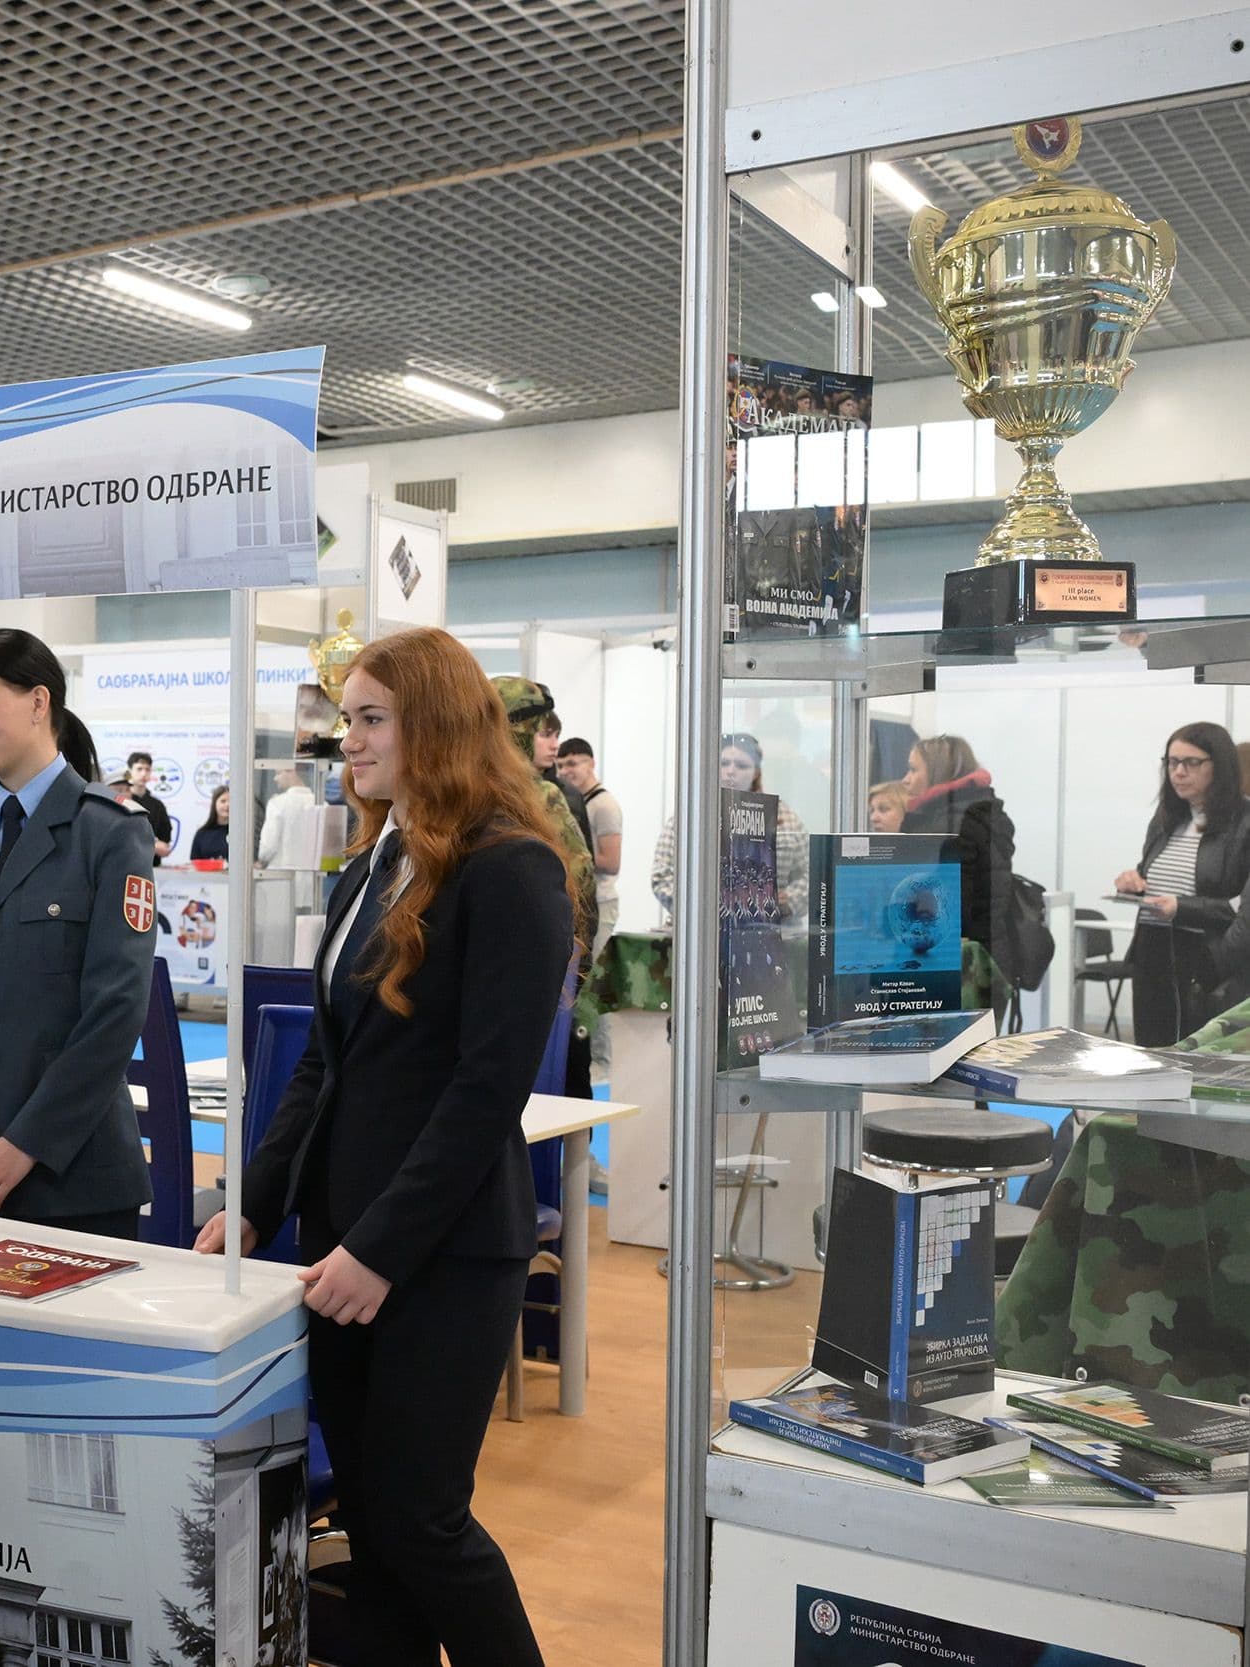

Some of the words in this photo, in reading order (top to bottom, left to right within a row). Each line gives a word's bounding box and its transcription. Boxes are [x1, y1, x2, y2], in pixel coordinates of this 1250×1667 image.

[146, 465, 272, 504] ОДБРАНЕ
[770, 587, 788, 599] МИ
[790, 589, 814, 601] СМО
[1077, 587, 1095, 595] place
[746, 599, 778, 615] ВОЈНА
[779, 603, 839, 620] АКАДЕМИЈА
[97, 671, 189, 690] САОБРАЋАЈНА
[193, 671, 230, 686] ШКОЛ
[730, 809, 765, 837] ОДБРАНА
[819, 882, 827, 928] СТРАТЕГИЈУ
[819, 935, 827, 957] УВОД
[735, 995, 764, 1015] УПИС
[854, 1003, 881, 1013] УВОД
[881, 1002, 889, 1011] У
[889, 1000, 943, 1011] СТРАТЕГИЈУ
[731, 1015, 753, 1028] ВОЈНЕ
[753, 1012, 779, 1025] ШКОЛЕ
[5, 1245, 111, 1270] ОДБРАНА
[926, 1339, 951, 1353] ЗБИРКА
[952, 1333, 989, 1347] ЗАДАТАКА
[926, 1355, 935, 1365] ИЗ
[934, 1345, 989, 1363] АУТО-ПАРКОВА
[850, 1614, 904, 1635] РЕПУБЛИКА
[907, 1628, 942, 1645] СРБИЈА
[850, 1627, 928, 1653] МИНИСТАРСТВО
[930, 1644, 976, 1665] ОДБРАНЕ
